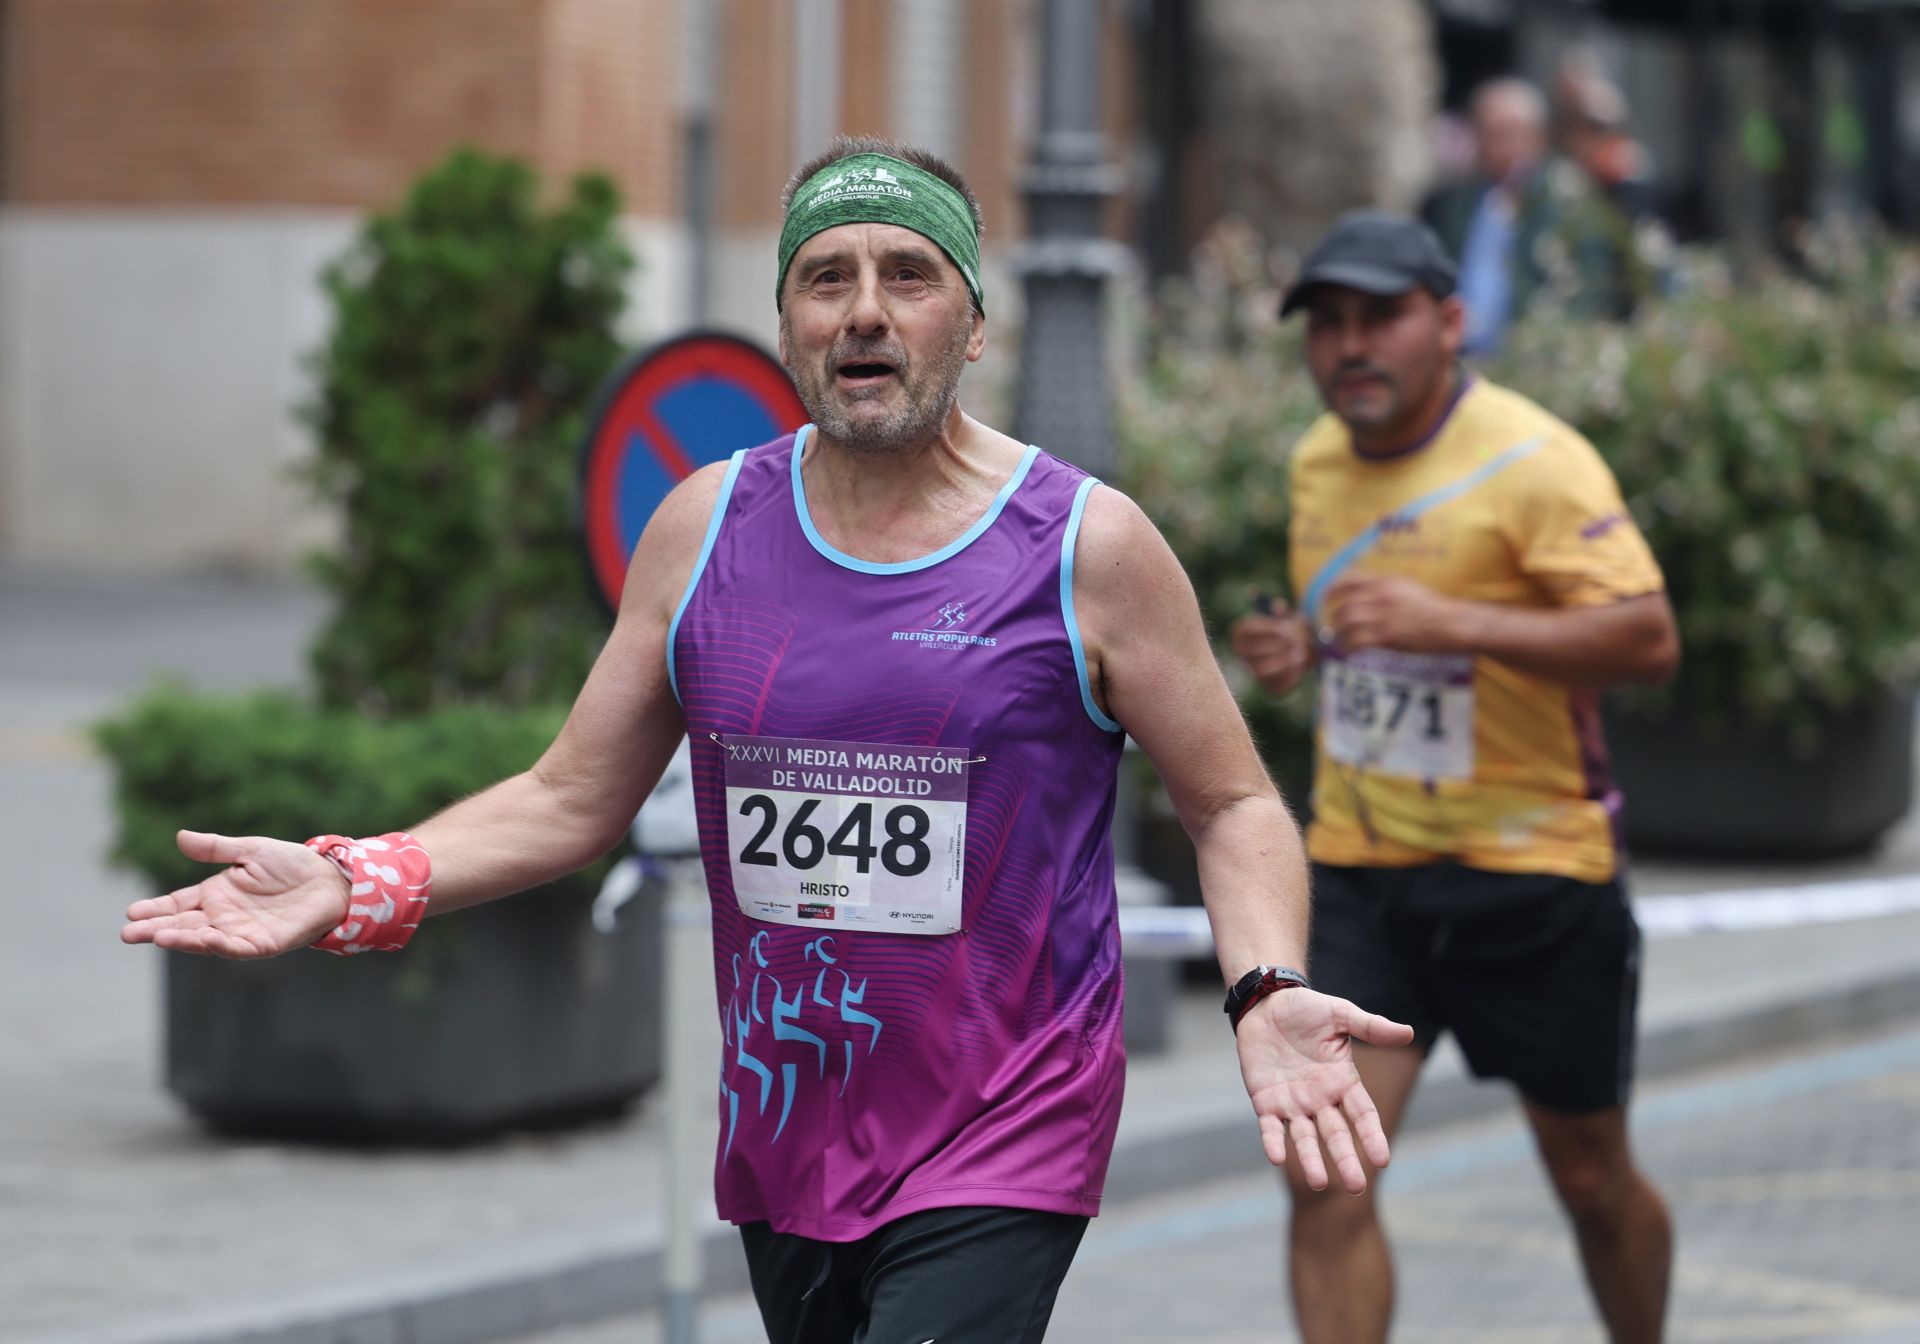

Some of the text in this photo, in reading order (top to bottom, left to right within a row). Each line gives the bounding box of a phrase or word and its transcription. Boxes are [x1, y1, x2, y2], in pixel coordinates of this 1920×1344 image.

[808, 183, 912, 208] MEDIA MARATÓN
[892, 631, 997, 647] ATLETAS POPULARES
[919, 641, 966, 650] VALLADOLID
[730, 744, 963, 775] XXXVI MEDIA MARATÓN
[772, 769, 932, 796] DE VALLADOLID
[738, 794, 931, 877] 2648
[800, 881, 850, 898] HRISTO
[801, 905, 824, 914] LABORAL
[902, 912, 934, 920] HYUNDAI
